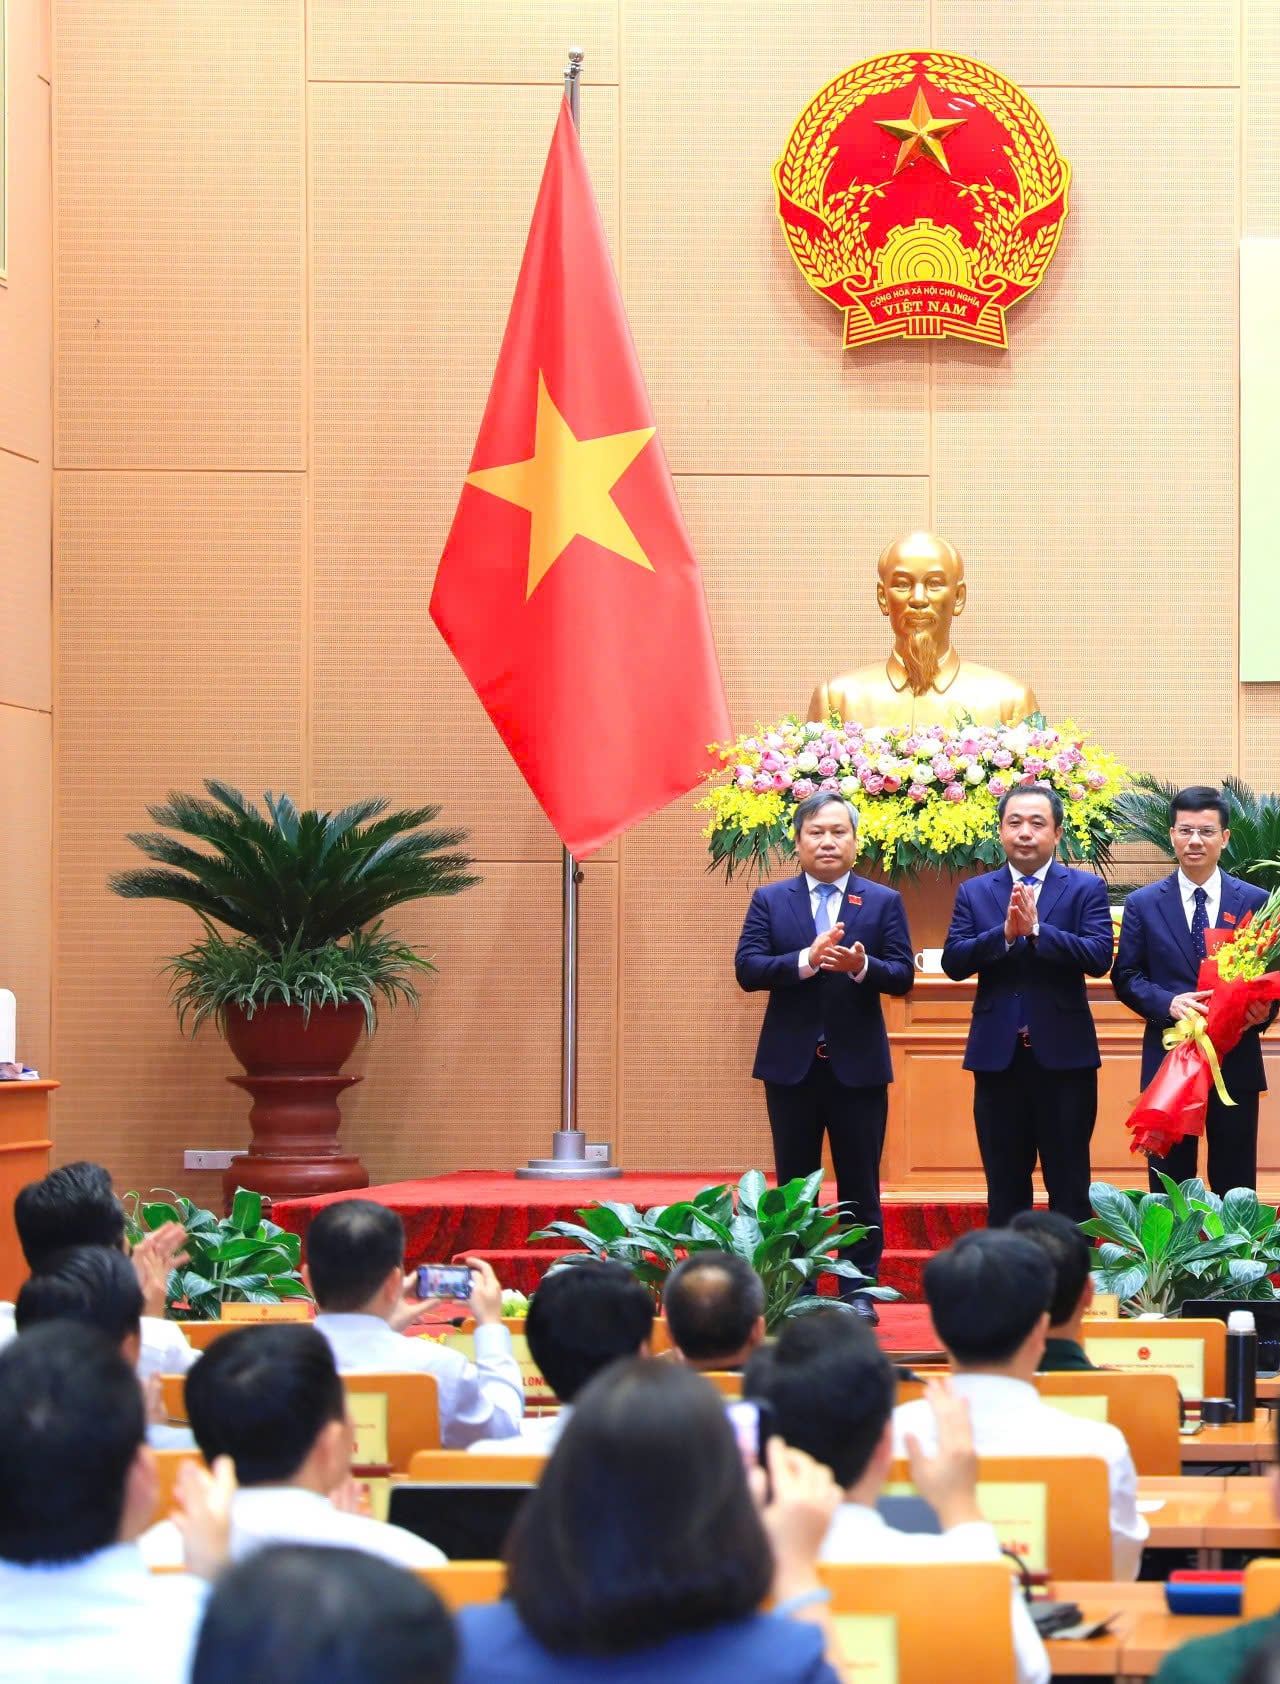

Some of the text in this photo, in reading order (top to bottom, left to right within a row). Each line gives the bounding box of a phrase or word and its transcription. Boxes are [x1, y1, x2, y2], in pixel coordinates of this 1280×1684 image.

[882, 298, 968, 316] VIỆT NAM
[522, 1376, 545, 1386] LON
